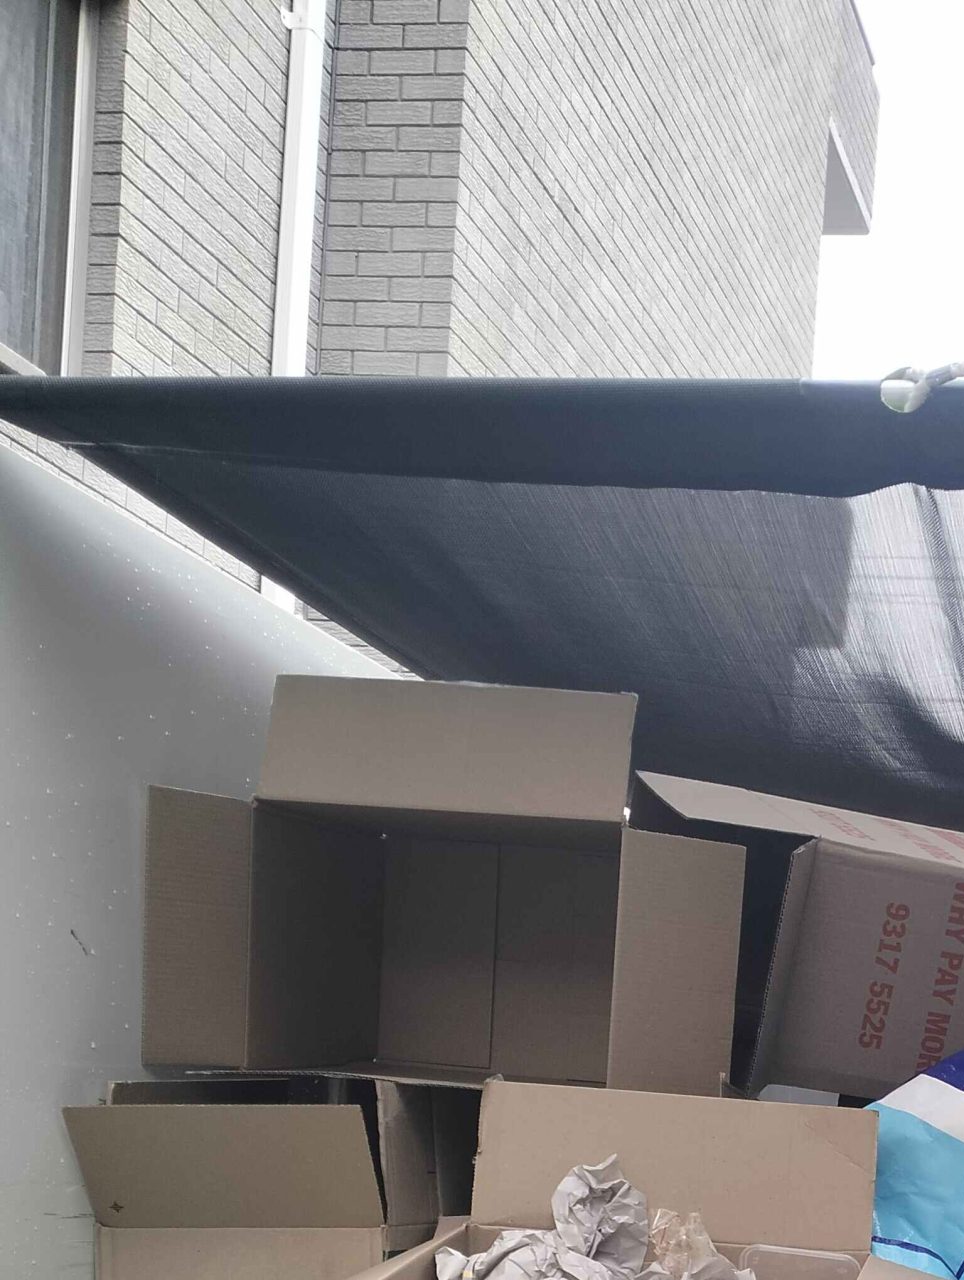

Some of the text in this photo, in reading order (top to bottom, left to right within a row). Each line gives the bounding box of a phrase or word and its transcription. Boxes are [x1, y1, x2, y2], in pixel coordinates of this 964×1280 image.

[858, 902, 911, 1050] 9317 5525
[931, 950, 964, 1008] PAY
[915, 1010, 951, 1073] MOR
